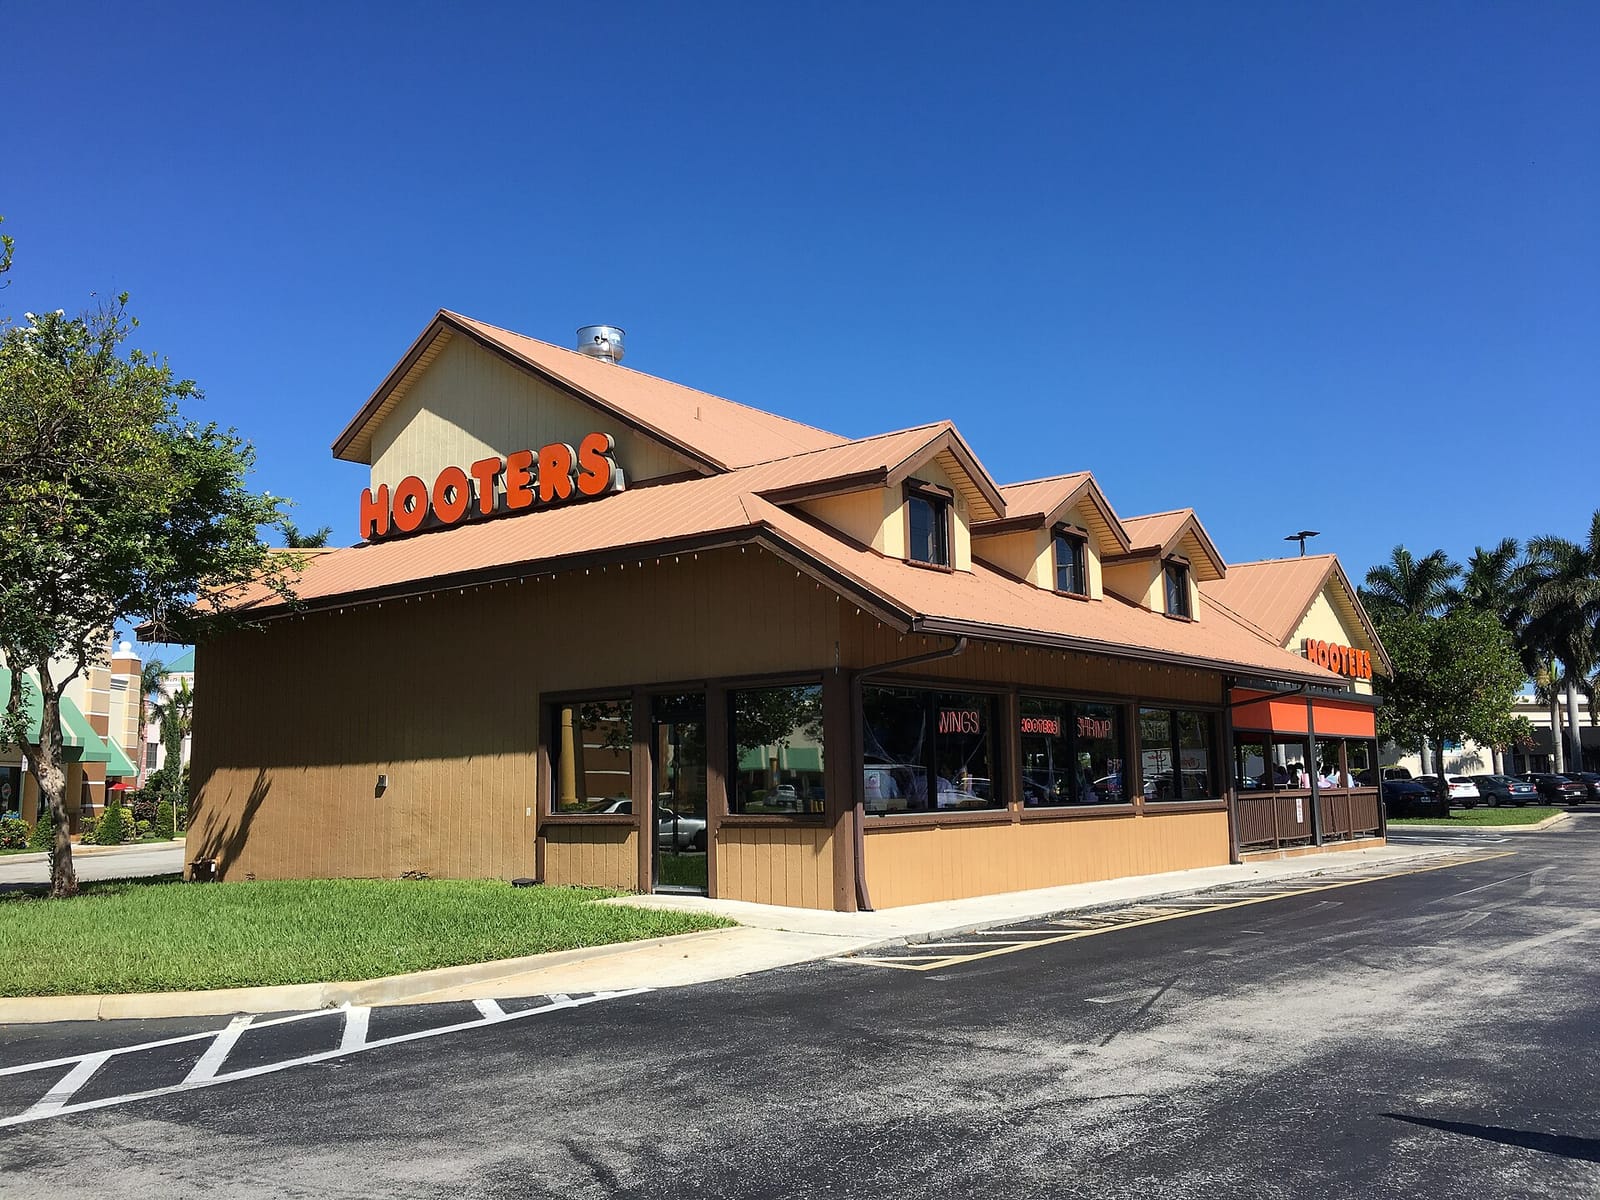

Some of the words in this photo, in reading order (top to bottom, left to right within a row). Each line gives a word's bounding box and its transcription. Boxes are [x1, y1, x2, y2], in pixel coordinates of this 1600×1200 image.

[360, 432, 611, 539] HOOTERS
[1306, 638, 1372, 680] HOOTERS
[939, 711, 979, 733] WINGS
[1077, 717, 1111, 738] SHRIMP
